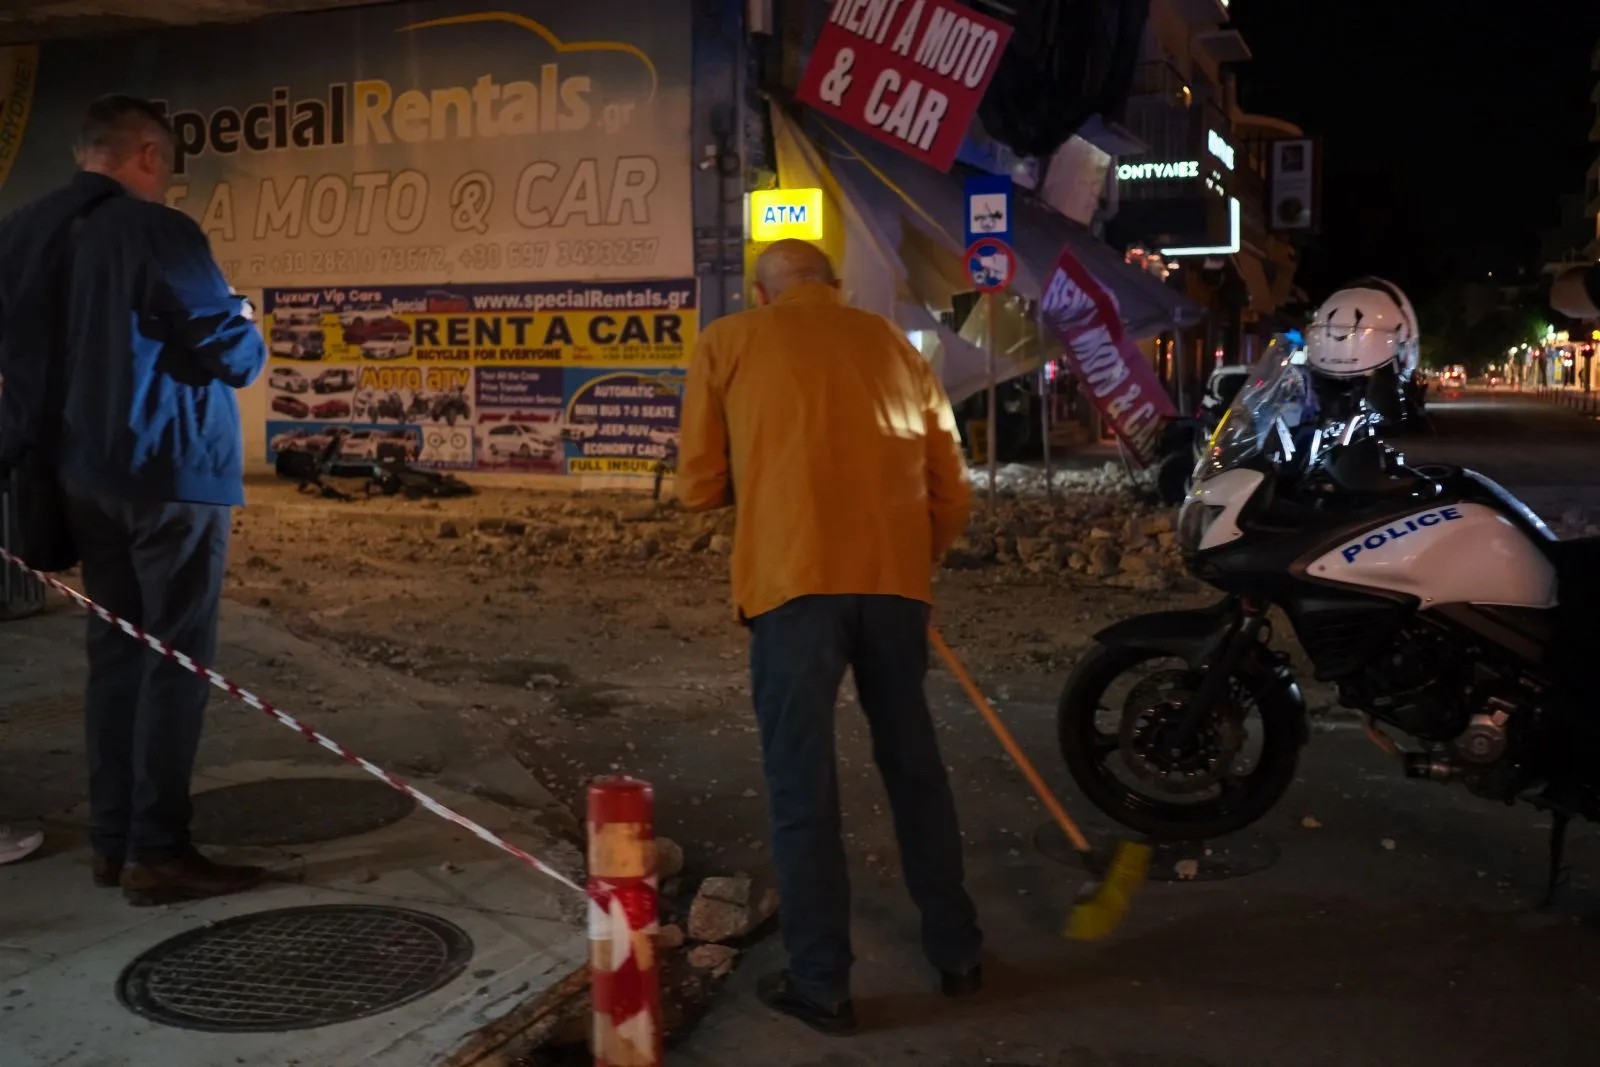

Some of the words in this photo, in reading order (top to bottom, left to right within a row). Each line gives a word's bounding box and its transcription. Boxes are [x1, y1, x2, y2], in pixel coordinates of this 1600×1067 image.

[891, 0, 926, 57] A
[914, 5, 999, 89] MOTO
[818, 46, 856, 107] &
[863, 67, 949, 152] CAR
[201, 180, 236, 242] A
[253, 166, 430, 242] MOTO
[449, 170, 496, 235] &
[513, 154, 660, 230] CAR
[763, 204, 807, 224] ATM
[275, 290, 320, 306] Luxury
[323, 288, 346, 304] Vip
[348, 289, 383, 302] Cars
[473, 289, 690, 312] www.specialRentals.gr
[415, 316, 534, 347] RENT
[544, 315, 573, 346] A
[588, 314, 683, 345] CAR
[474, 348, 496, 361] FOR
[500, 347, 562, 360] EVERYONE
[593, 385, 655, 399] AUTOMATIC
[583, 441, 635, 456] ECONOMY
[570, 460, 605, 473] FULL
[1341, 507, 1463, 564] POLICE
